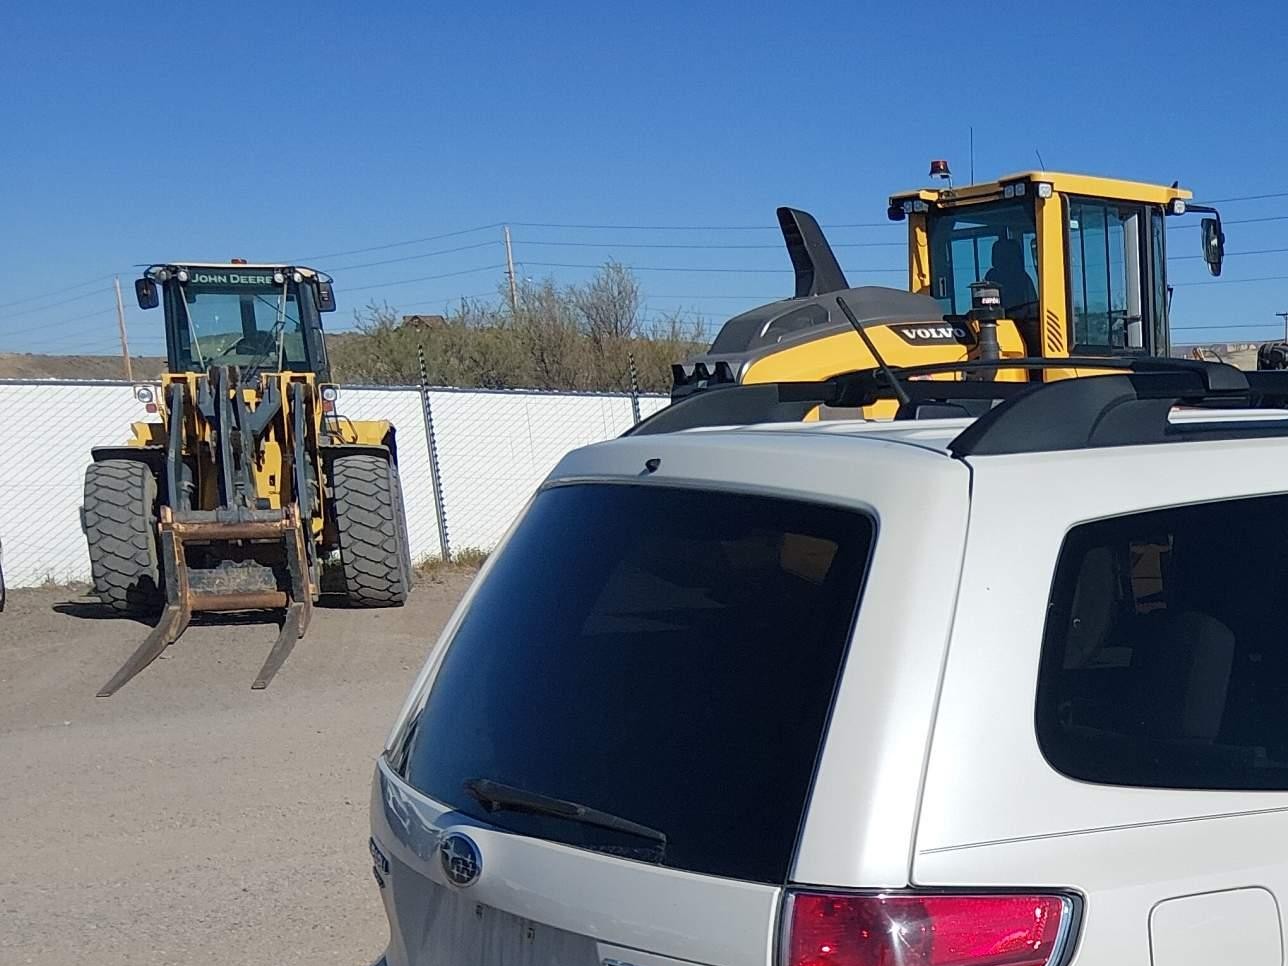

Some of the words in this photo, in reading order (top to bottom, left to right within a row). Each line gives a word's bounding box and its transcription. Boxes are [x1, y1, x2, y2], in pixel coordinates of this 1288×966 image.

[191, 273, 227, 283] JOHN
[229, 274, 273, 284] DEERE
[901, 327, 966, 340] VOLVO
